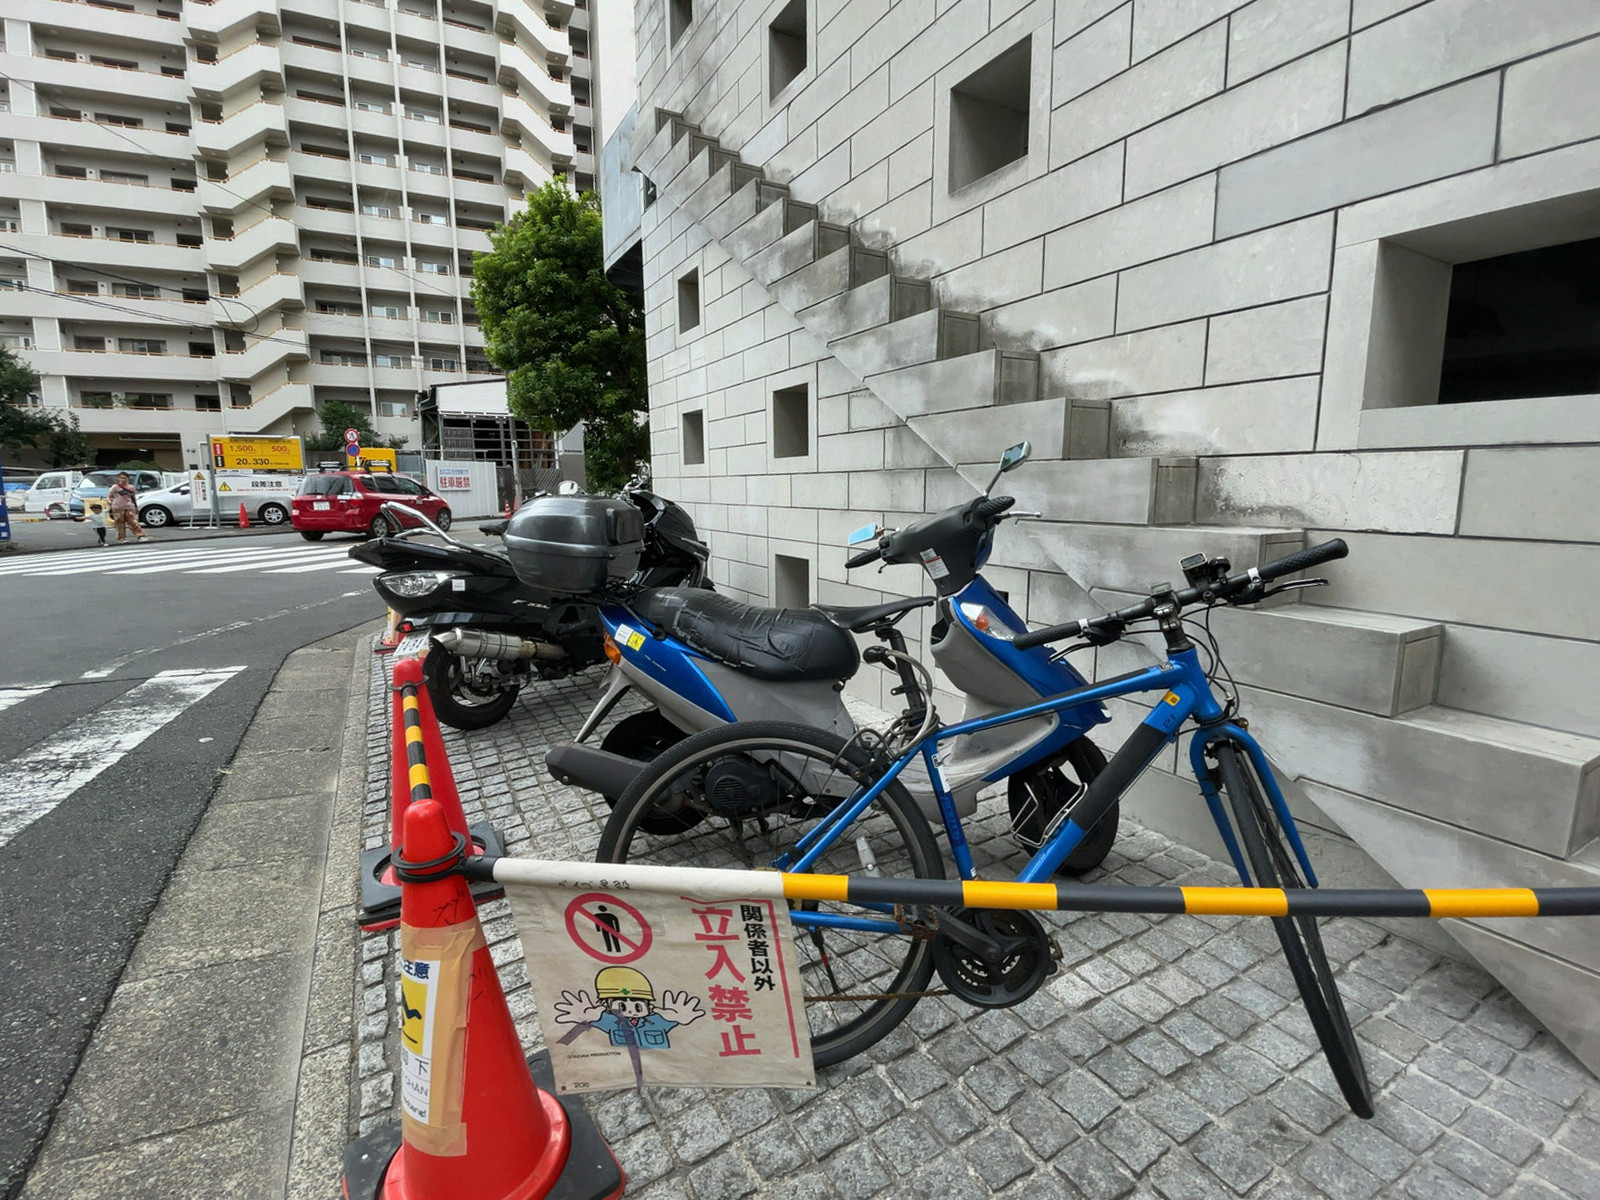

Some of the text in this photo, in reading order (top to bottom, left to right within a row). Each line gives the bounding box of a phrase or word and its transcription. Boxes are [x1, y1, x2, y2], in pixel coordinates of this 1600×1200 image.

[692, 906, 762, 1058] 立入禁止
[740, 904, 776, 992] 関係者以外
